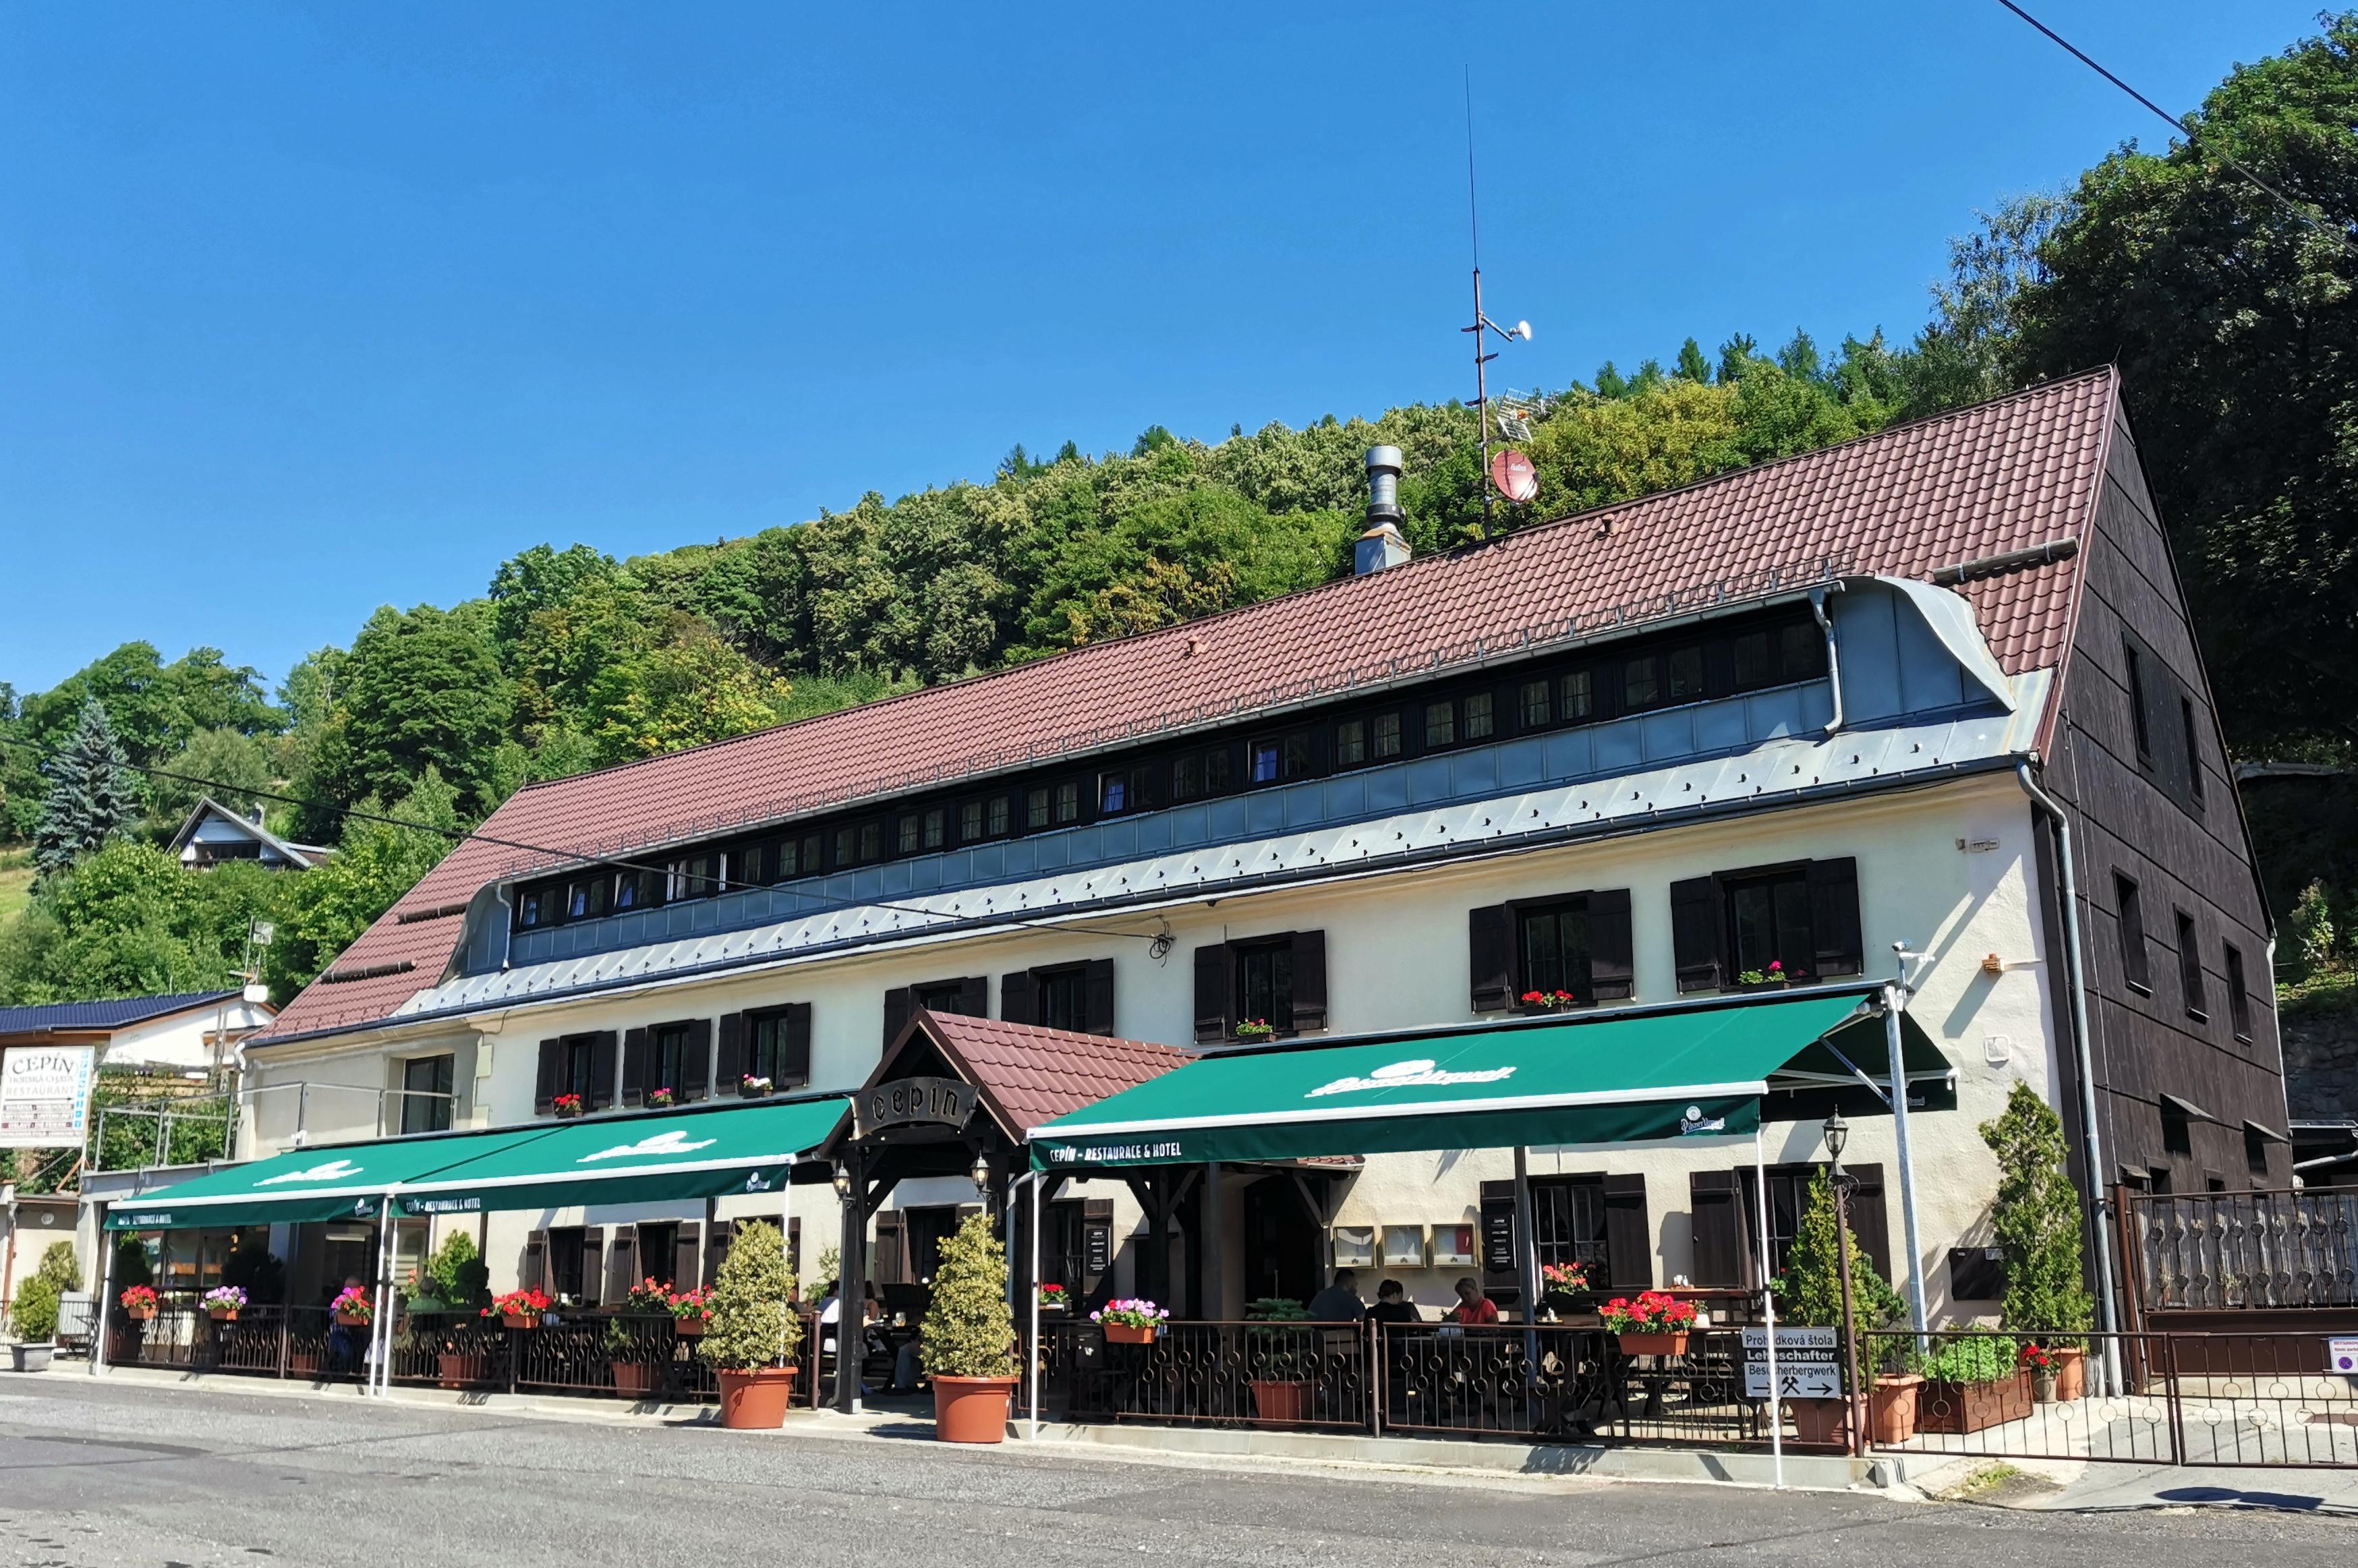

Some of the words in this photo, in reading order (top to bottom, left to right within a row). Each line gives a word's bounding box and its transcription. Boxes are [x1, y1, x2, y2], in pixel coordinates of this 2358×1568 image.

[12, 1052, 74, 1074] CEPÍN
[6, 1086, 75, 1096] RESTAURANT
[1049, 1146, 1076, 1163] CEPÍN
[1084, 1145, 1141, 1161] RESTAURACE
[1144, 1144, 1151, 1157] &
[1153, 1142, 1182, 1157] HOTEL
[1746, 1334, 1806, 1346] Prohdková
[1808, 1335, 1833, 1345] štola
